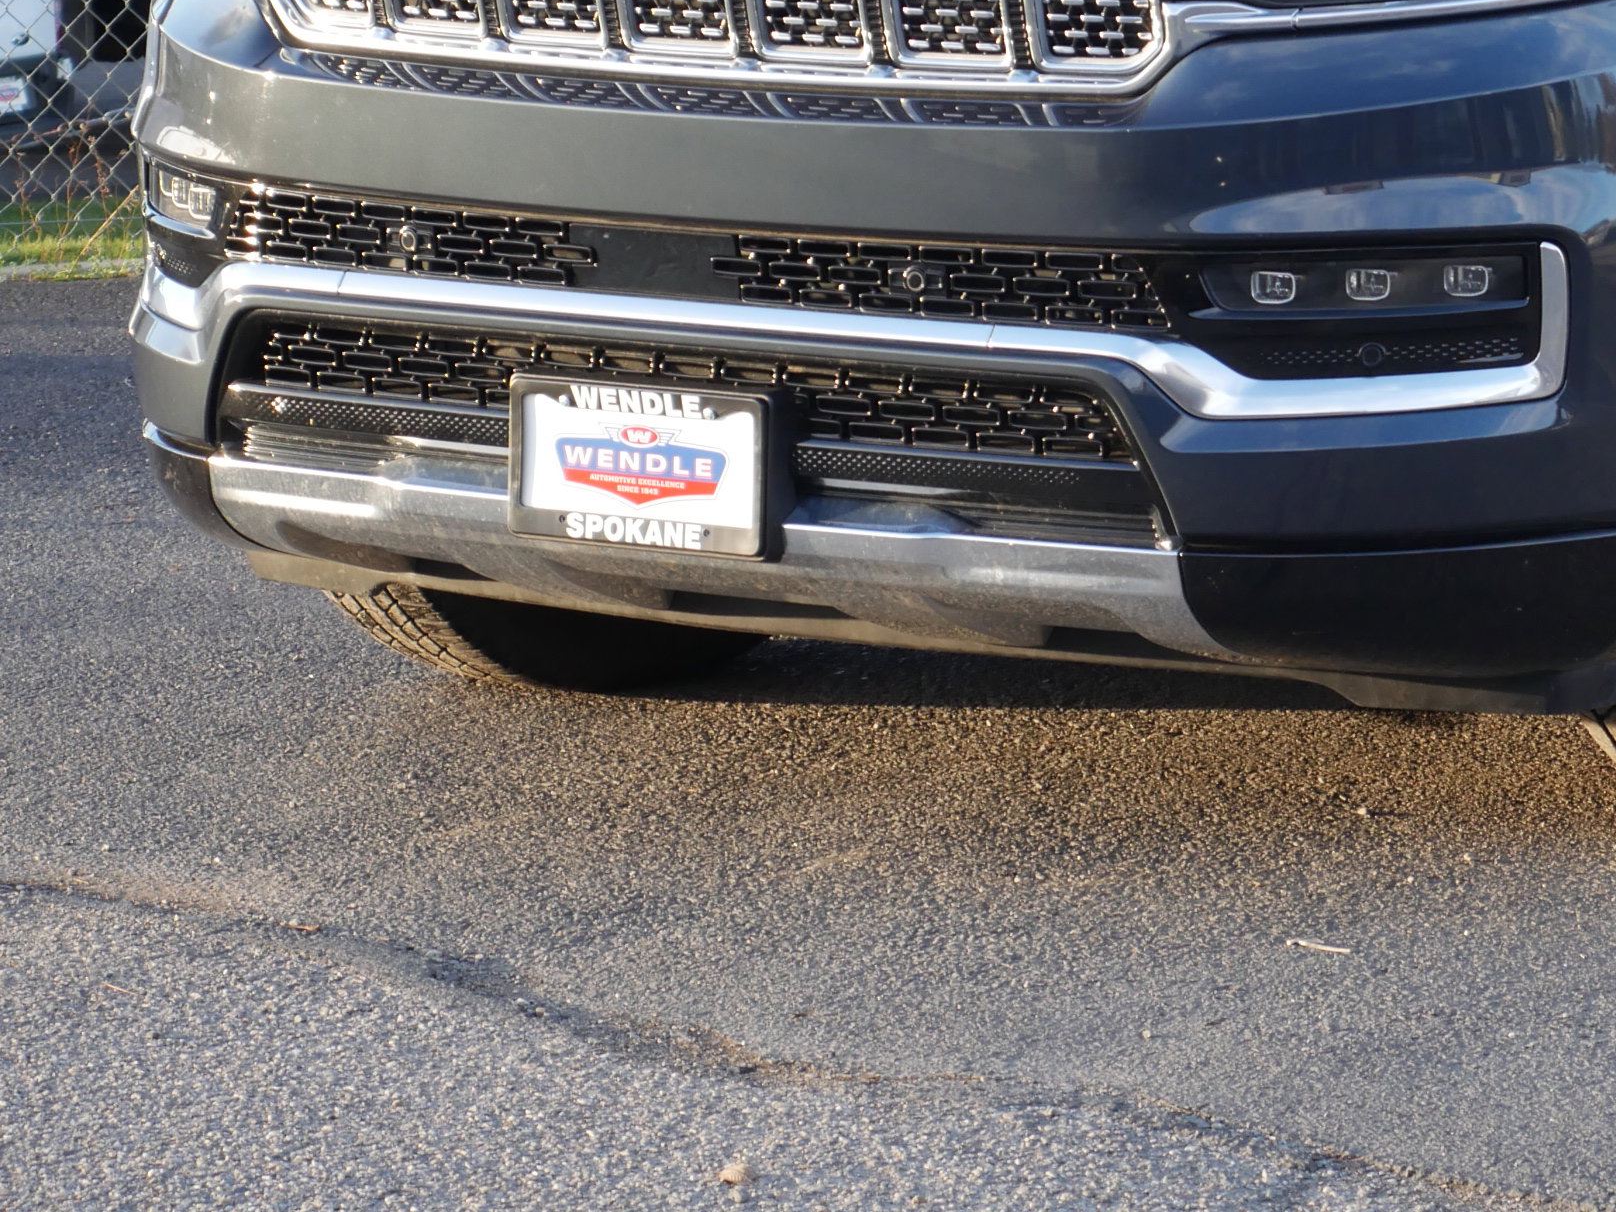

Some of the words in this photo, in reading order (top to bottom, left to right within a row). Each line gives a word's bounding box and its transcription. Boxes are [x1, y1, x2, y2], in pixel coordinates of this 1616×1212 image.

[570, 384, 702, 419] WENDLE
[564, 444, 713, 478] WENDLE
[589, 473, 637, 485] AUTOMOTIVE
[638, 478, 686, 490] EXCELLENCE
[617, 485, 640, 494] SINCE
[565, 512, 702, 550] SPOKANE
